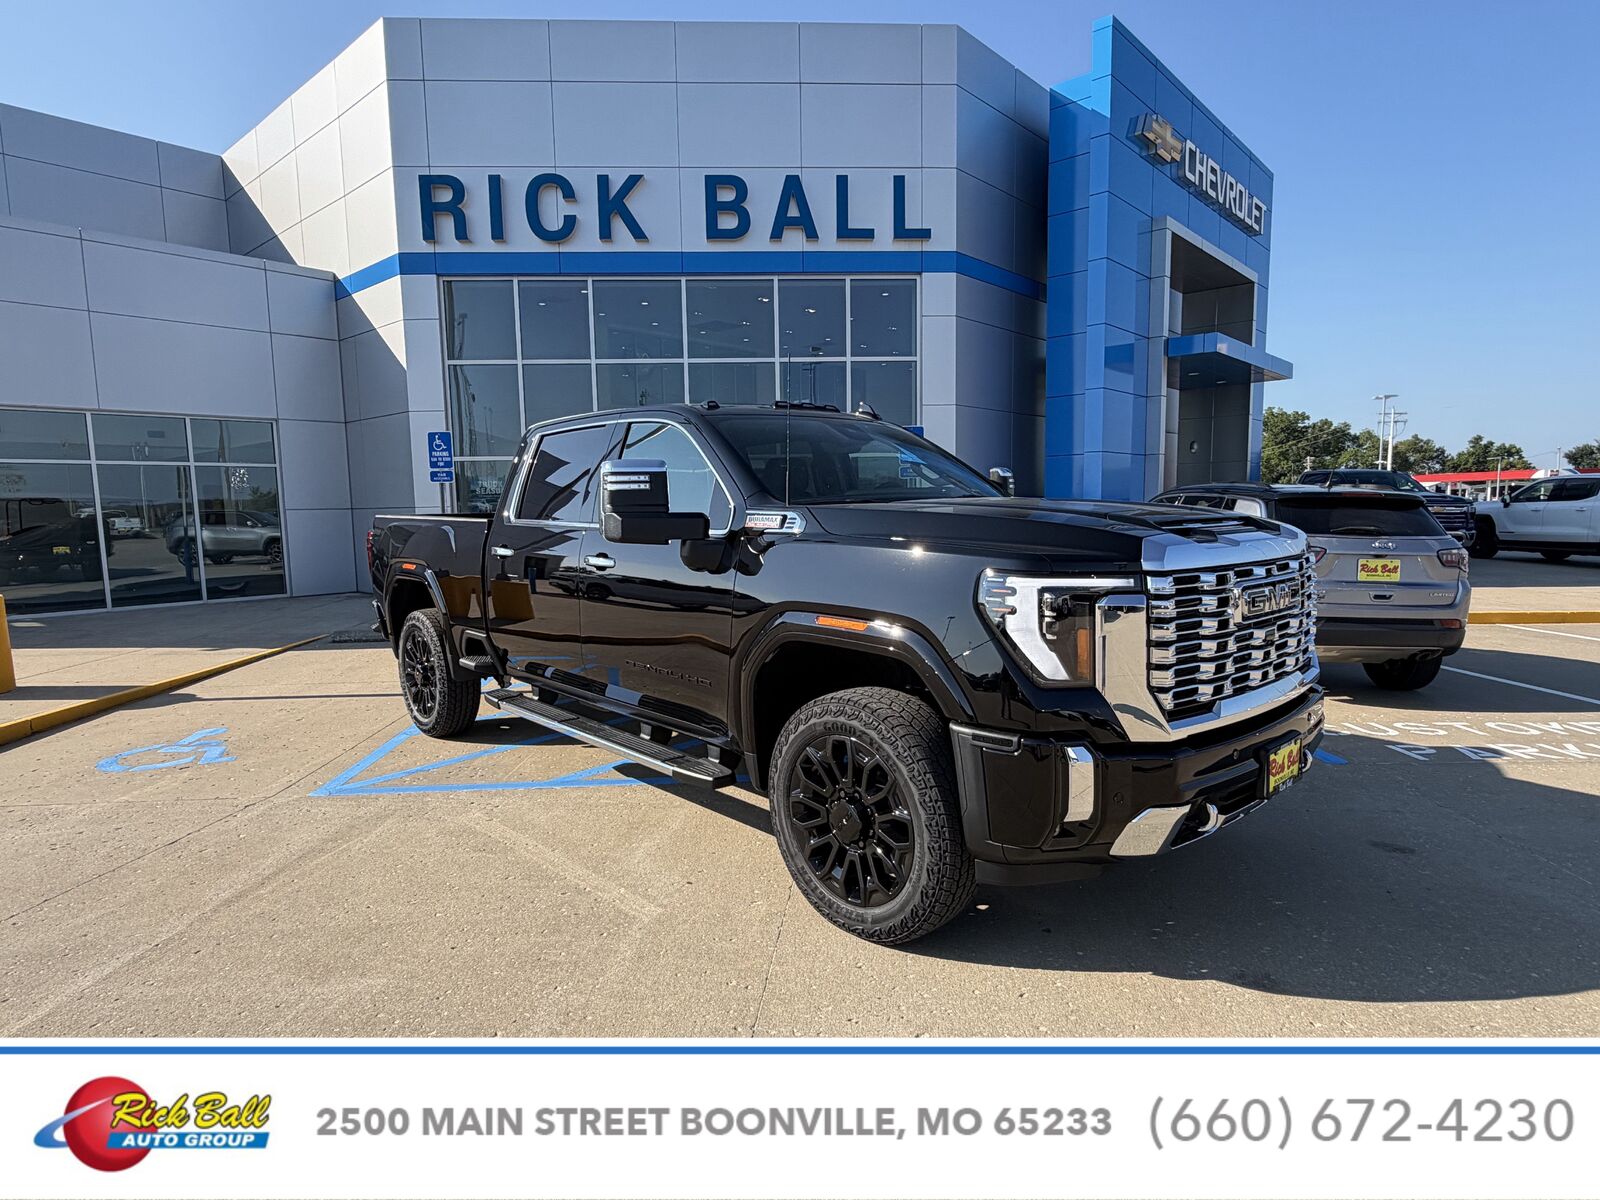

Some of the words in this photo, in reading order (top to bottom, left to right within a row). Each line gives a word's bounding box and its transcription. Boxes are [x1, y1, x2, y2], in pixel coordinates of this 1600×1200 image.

[1184, 139, 1267, 235] CHEVROLET
[418, 173, 649, 242] RICK
[703, 174, 932, 241] BALL
[475, 487, 501, 495] SEASO
[1360, 563, 1379, 574] Rick
[1380, 563, 1399, 574] Ball
[1243, 580, 1300, 616] GMC
